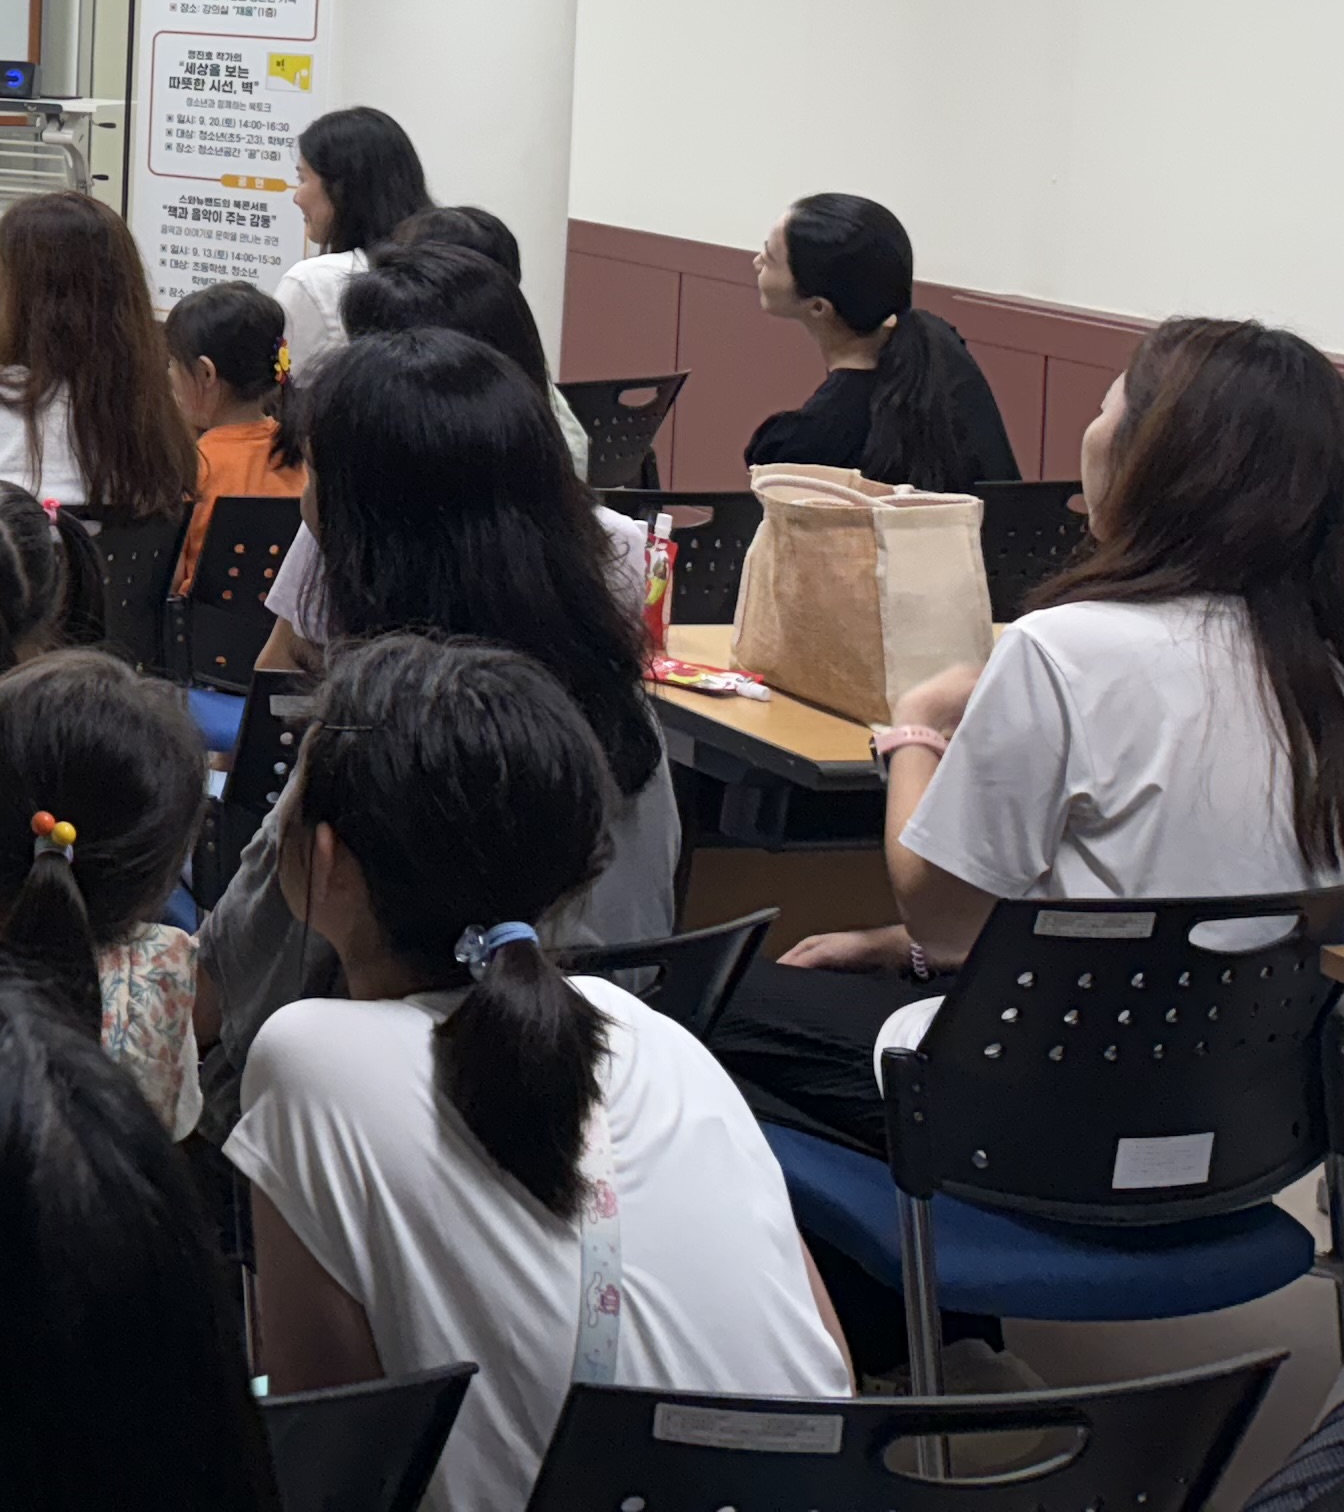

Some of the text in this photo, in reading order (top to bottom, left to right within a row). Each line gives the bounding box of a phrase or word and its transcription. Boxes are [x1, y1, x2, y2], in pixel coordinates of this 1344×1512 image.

[202, 4, 229, 15] 강의실
[216, 51, 242, 63] 작가의
[224, 64, 249, 79] 보는
[168, 76, 205, 91] 따뜻한
[209, 78, 237, 95] 시선,
[248, 101, 272, 113] 북토크
[176, 114, 196, 125] 일시:
[175, 128, 196, 139] 대상:
[267, 135, 295, 148] 학부모
[175, 142, 196, 154] 장소:
[198, 144, 241, 158] 청소년공간
[233, 199, 268, 213] 북콘서트
[191, 207, 222, 223] 음악이
[225, 211, 246, 227] 주는
[160, 224, 279, 247] 음악과 이야기로 문학을 만나는 공연
[170, 244, 190, 255] 일시:
[169, 258, 190, 270] 대상:
